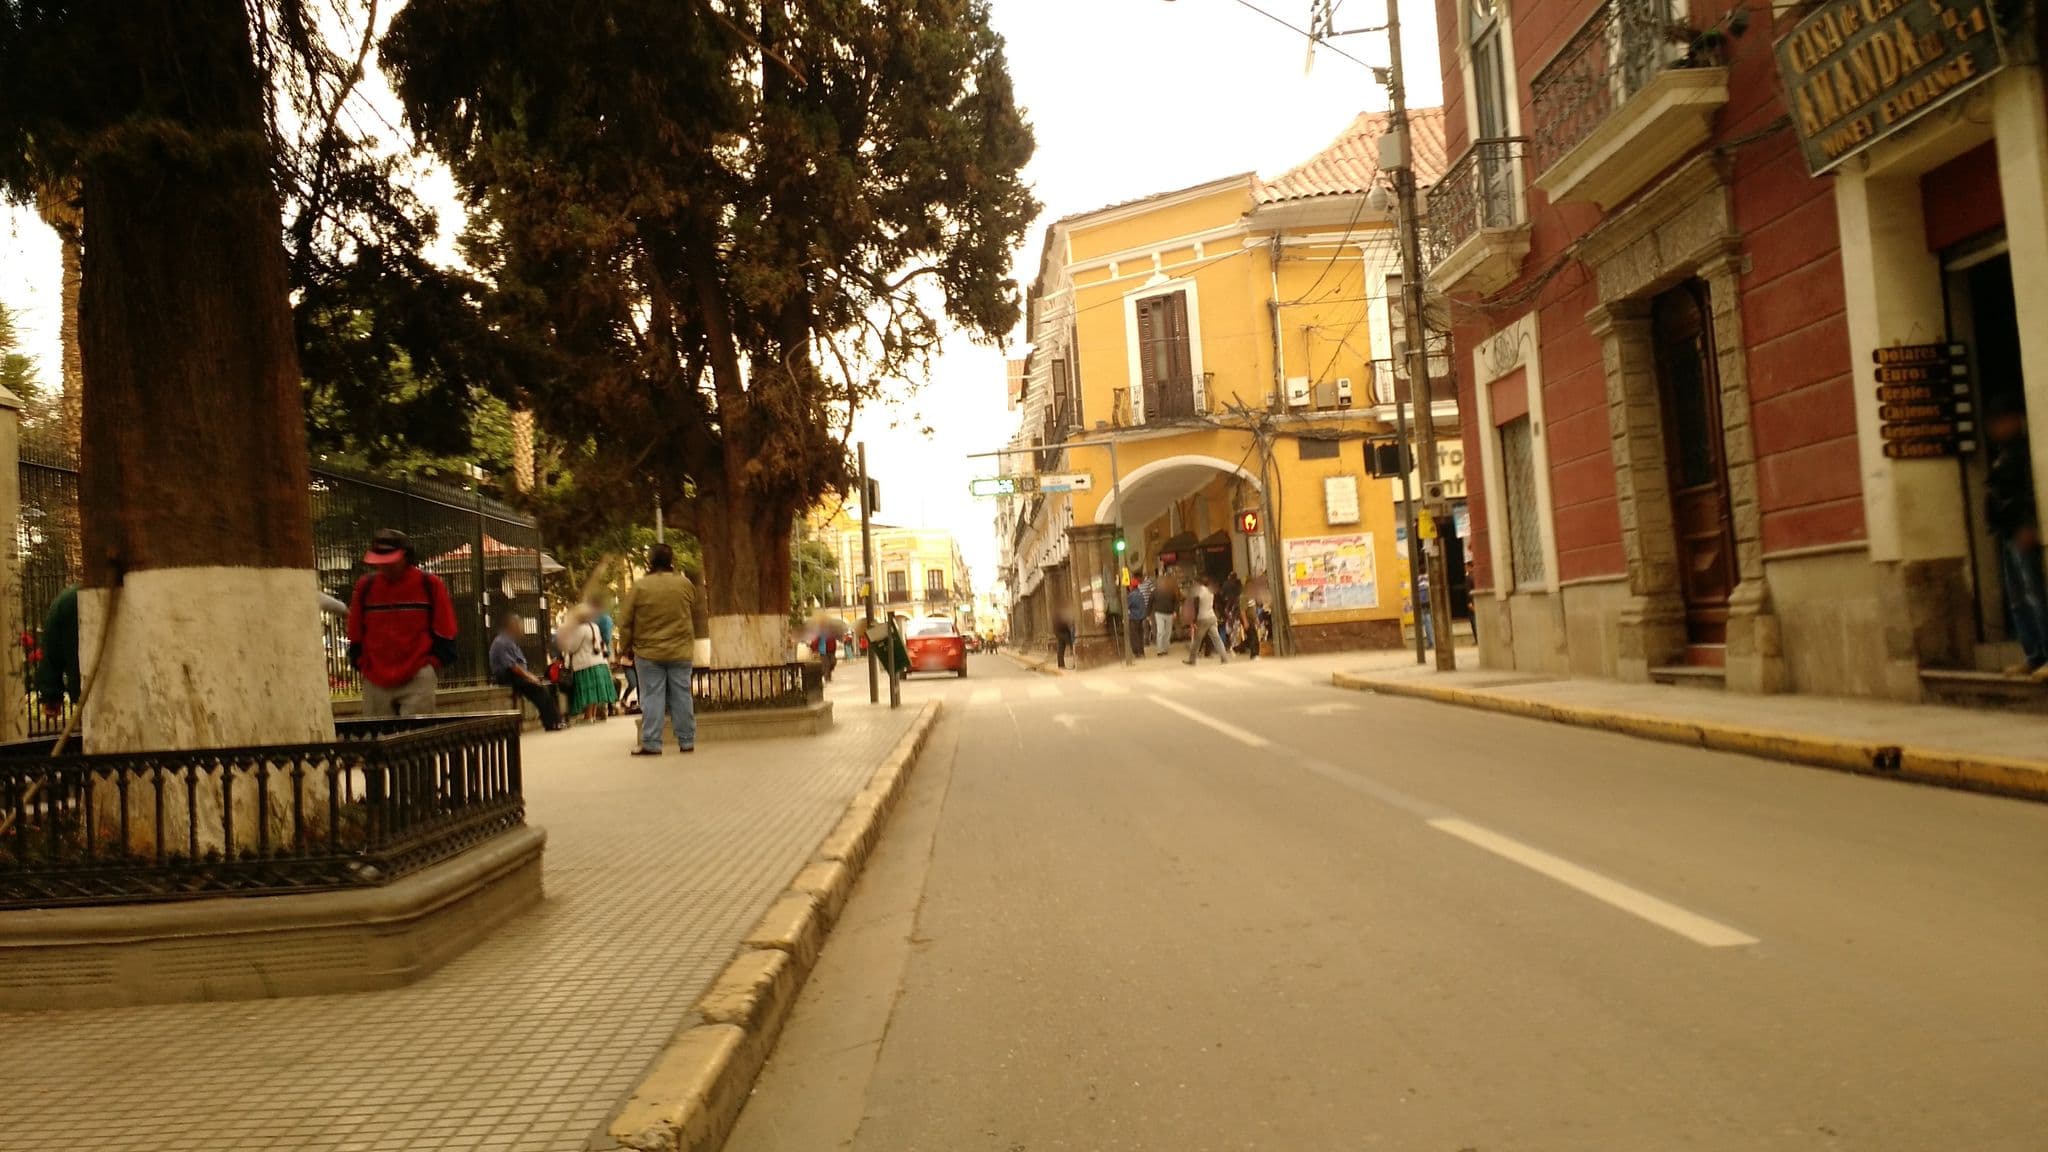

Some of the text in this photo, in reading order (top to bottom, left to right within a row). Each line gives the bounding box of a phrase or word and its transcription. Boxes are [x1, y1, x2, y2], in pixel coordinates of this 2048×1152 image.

[1788, 11, 1843, 73] CASA
[1796, 16, 1922, 138] AMANDA
[1822, 52, 1976, 157] MONEY EXCHANGE
[1881, 367, 1928, 381] Euros
